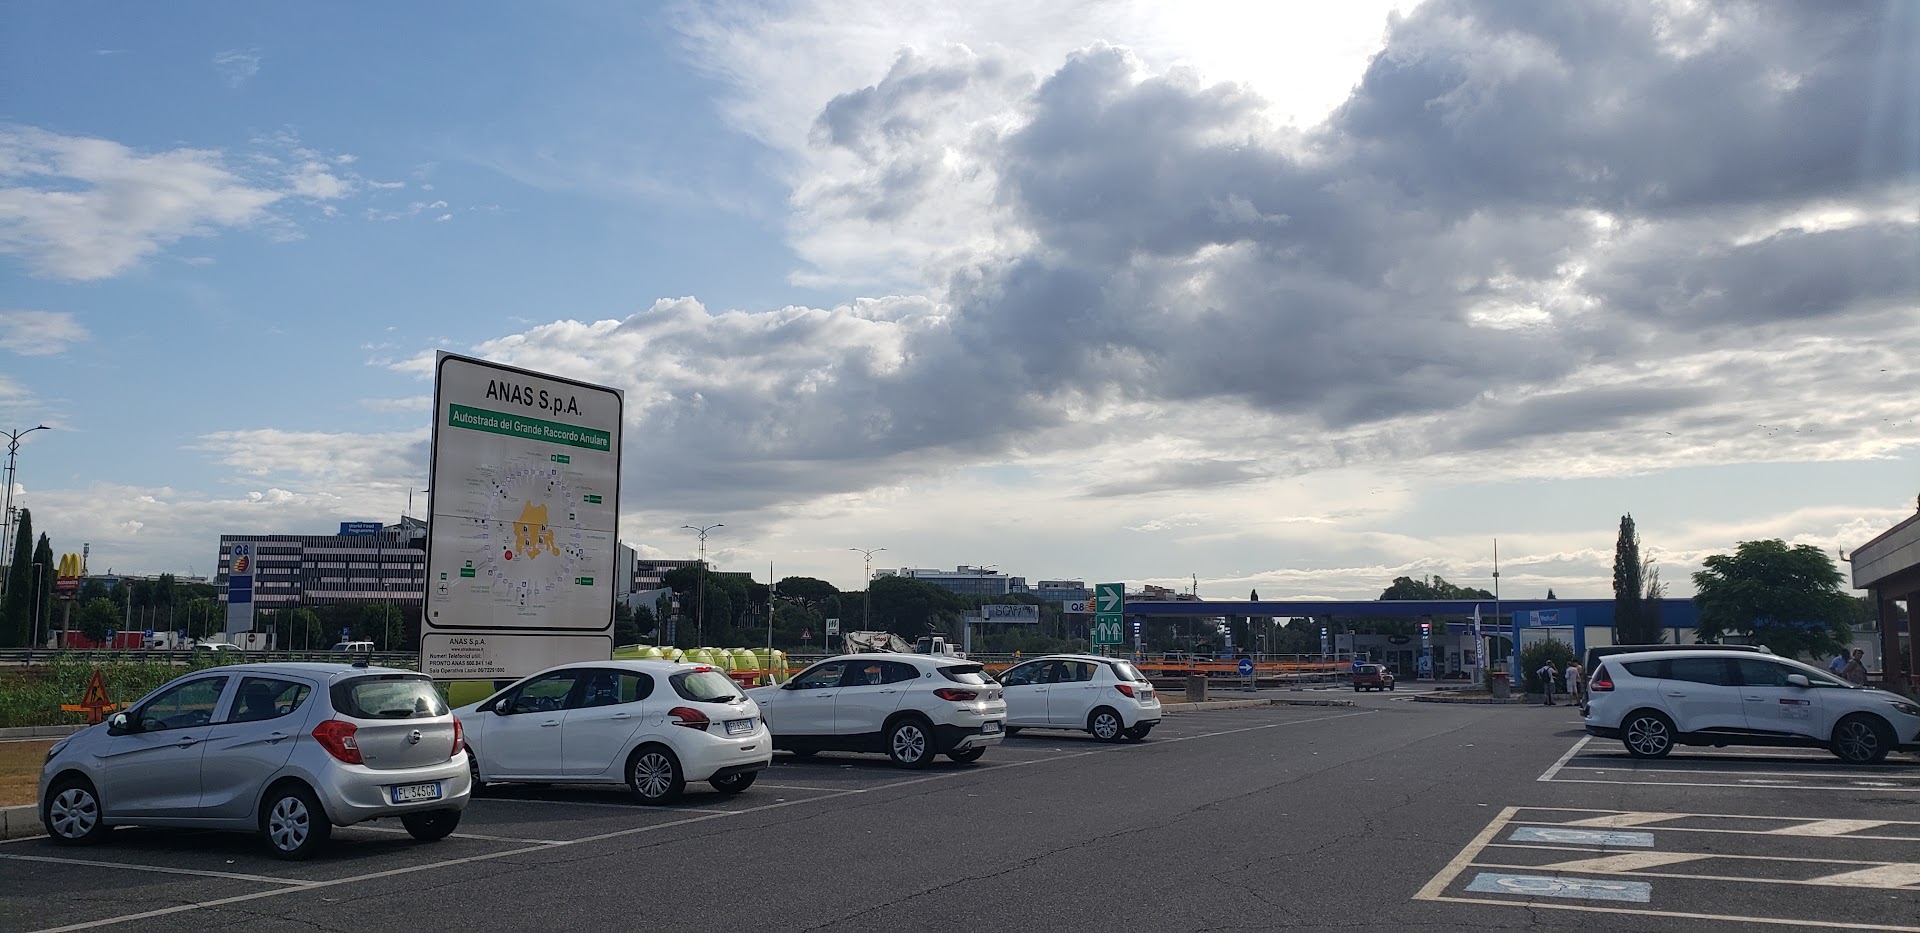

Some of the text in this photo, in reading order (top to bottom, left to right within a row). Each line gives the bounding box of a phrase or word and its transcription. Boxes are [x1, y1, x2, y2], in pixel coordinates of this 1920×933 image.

[486, 379, 583, 417] ANAS S.p.A.
[453, 410, 608, 447] Autostrada del Grande Raccordo Anulare
[234, 544, 250, 556] Q8
[1071, 602, 1085, 612] Q8
[469, 638, 487, 646] S.p.A.
[410, 784, 437, 798] 345GR
